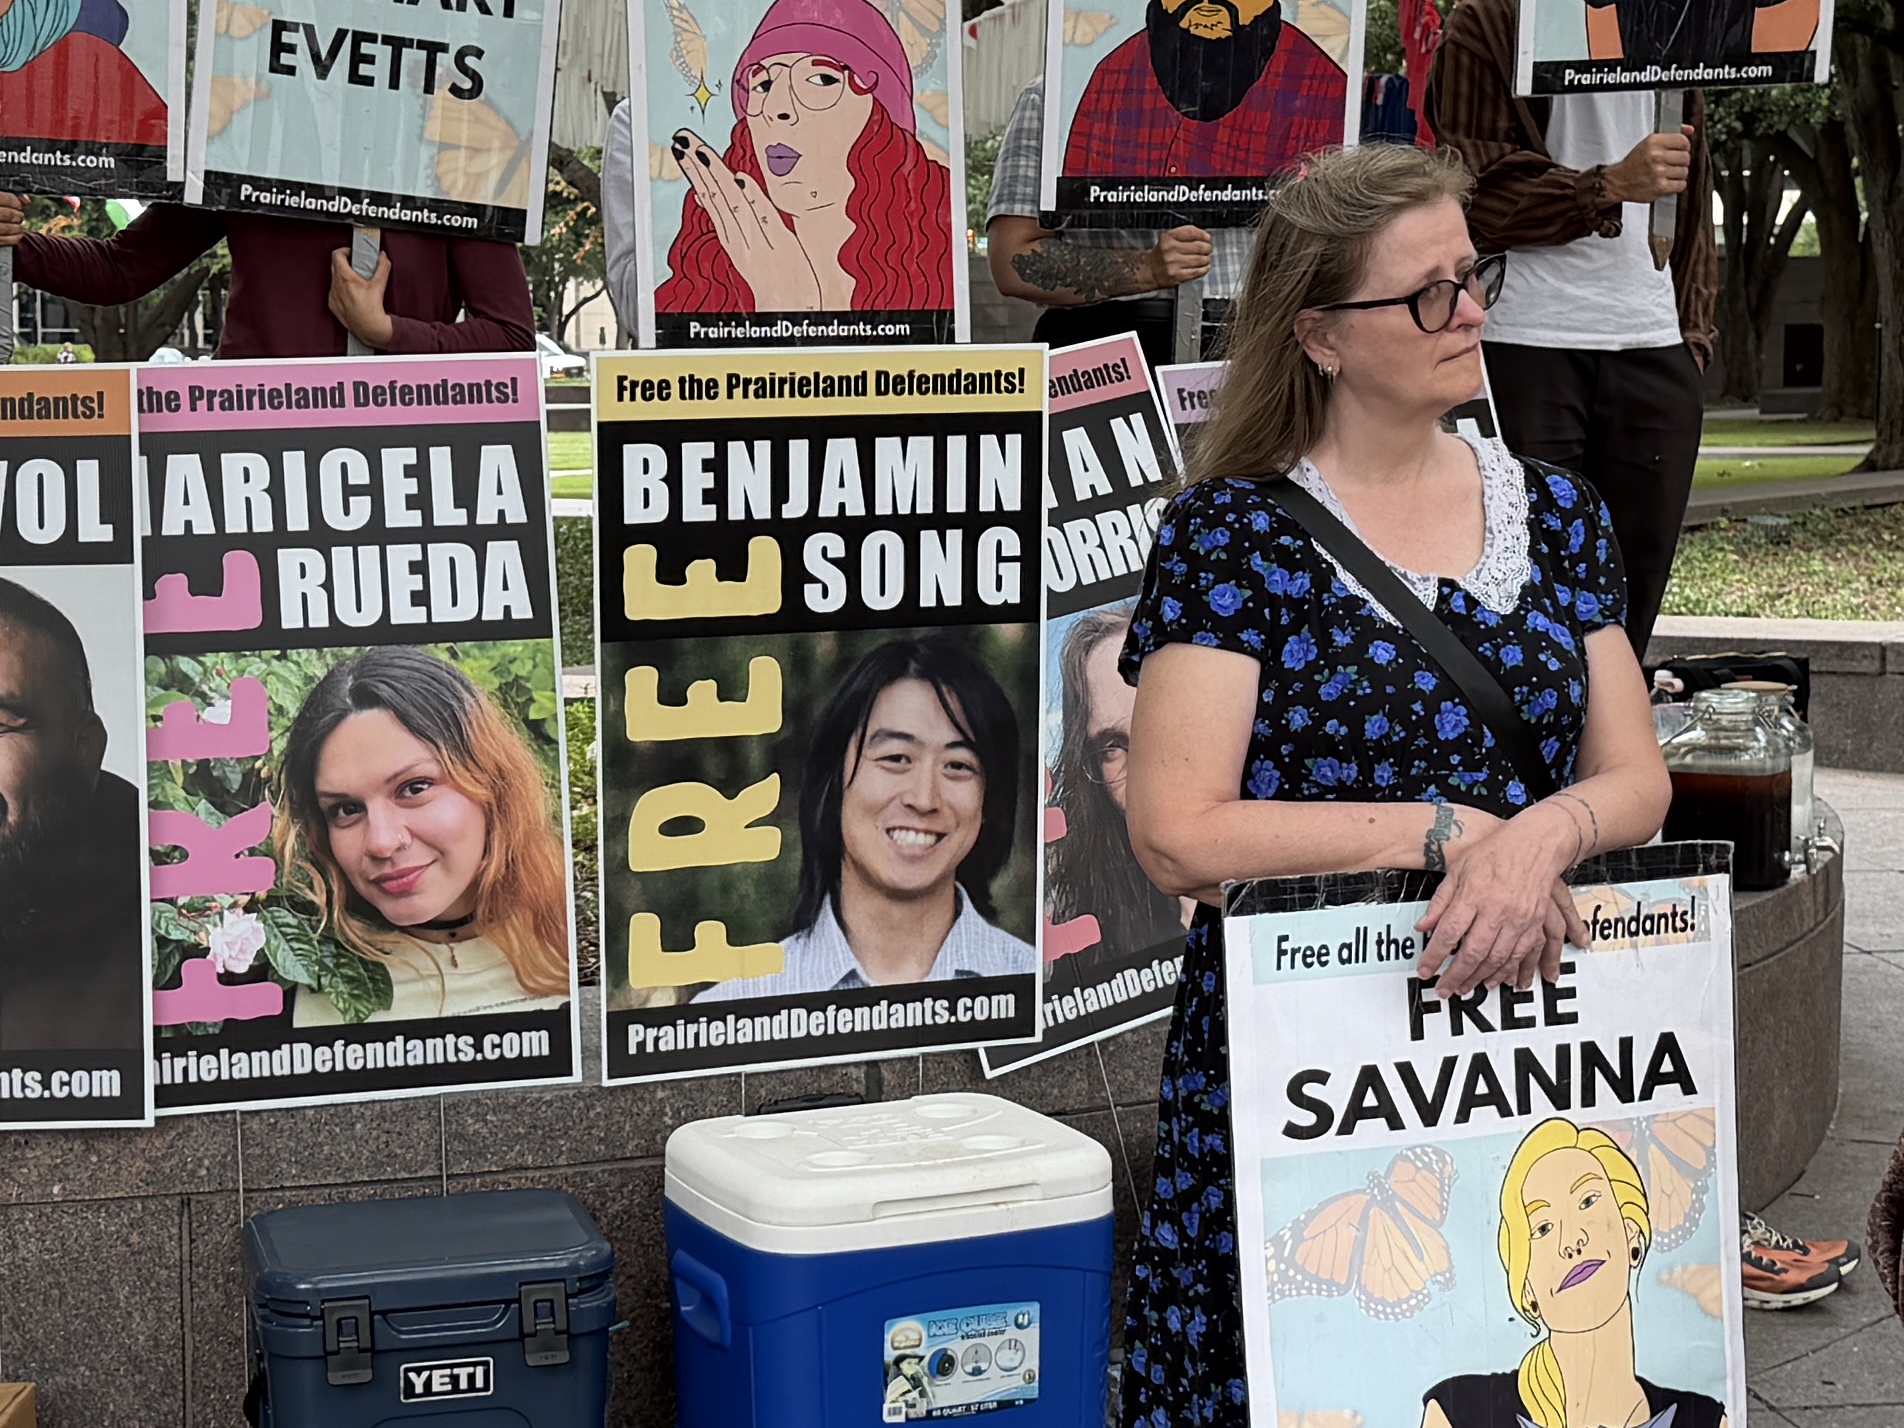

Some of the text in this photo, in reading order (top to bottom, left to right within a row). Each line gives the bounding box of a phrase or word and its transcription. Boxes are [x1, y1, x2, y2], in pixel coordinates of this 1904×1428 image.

[268, 19, 485, 100] EVETTS
[1564, 63, 1772, 86] PrairielandDefendants.com
[240, 184, 478, 229] PrairielandDefendants.com
[690, 320, 910, 339] PrairielandDefendants.com
[189, 381, 345, 412] Prairieland
[352, 377, 519, 408] Defendants!
[616, 367, 1025, 403] Free the Prairieland Defendants!
[622, 434, 1022, 525] BENJAMIN
[1048, 412, 1163, 509] AN
[803, 526, 1022, 613] SONG
[1046, 498, 1169, 593] ORRI
[277, 540, 533, 629] RUEDA
[623, 535, 785, 989] FREE
[1276, 934, 1329, 971] Free
[1337, 926, 1368, 965] all
[1376, 924, 1415, 962] the
[1581, 896, 1696, 942] fendants!
[154, 1026, 549, 1087] irielandDefendants.com
[627, 991, 1015, 1055] PrairielandDefendants.com
[1281, 1031, 1698, 1140] SAVANNA
[407, 1366, 484, 1394] YETI
